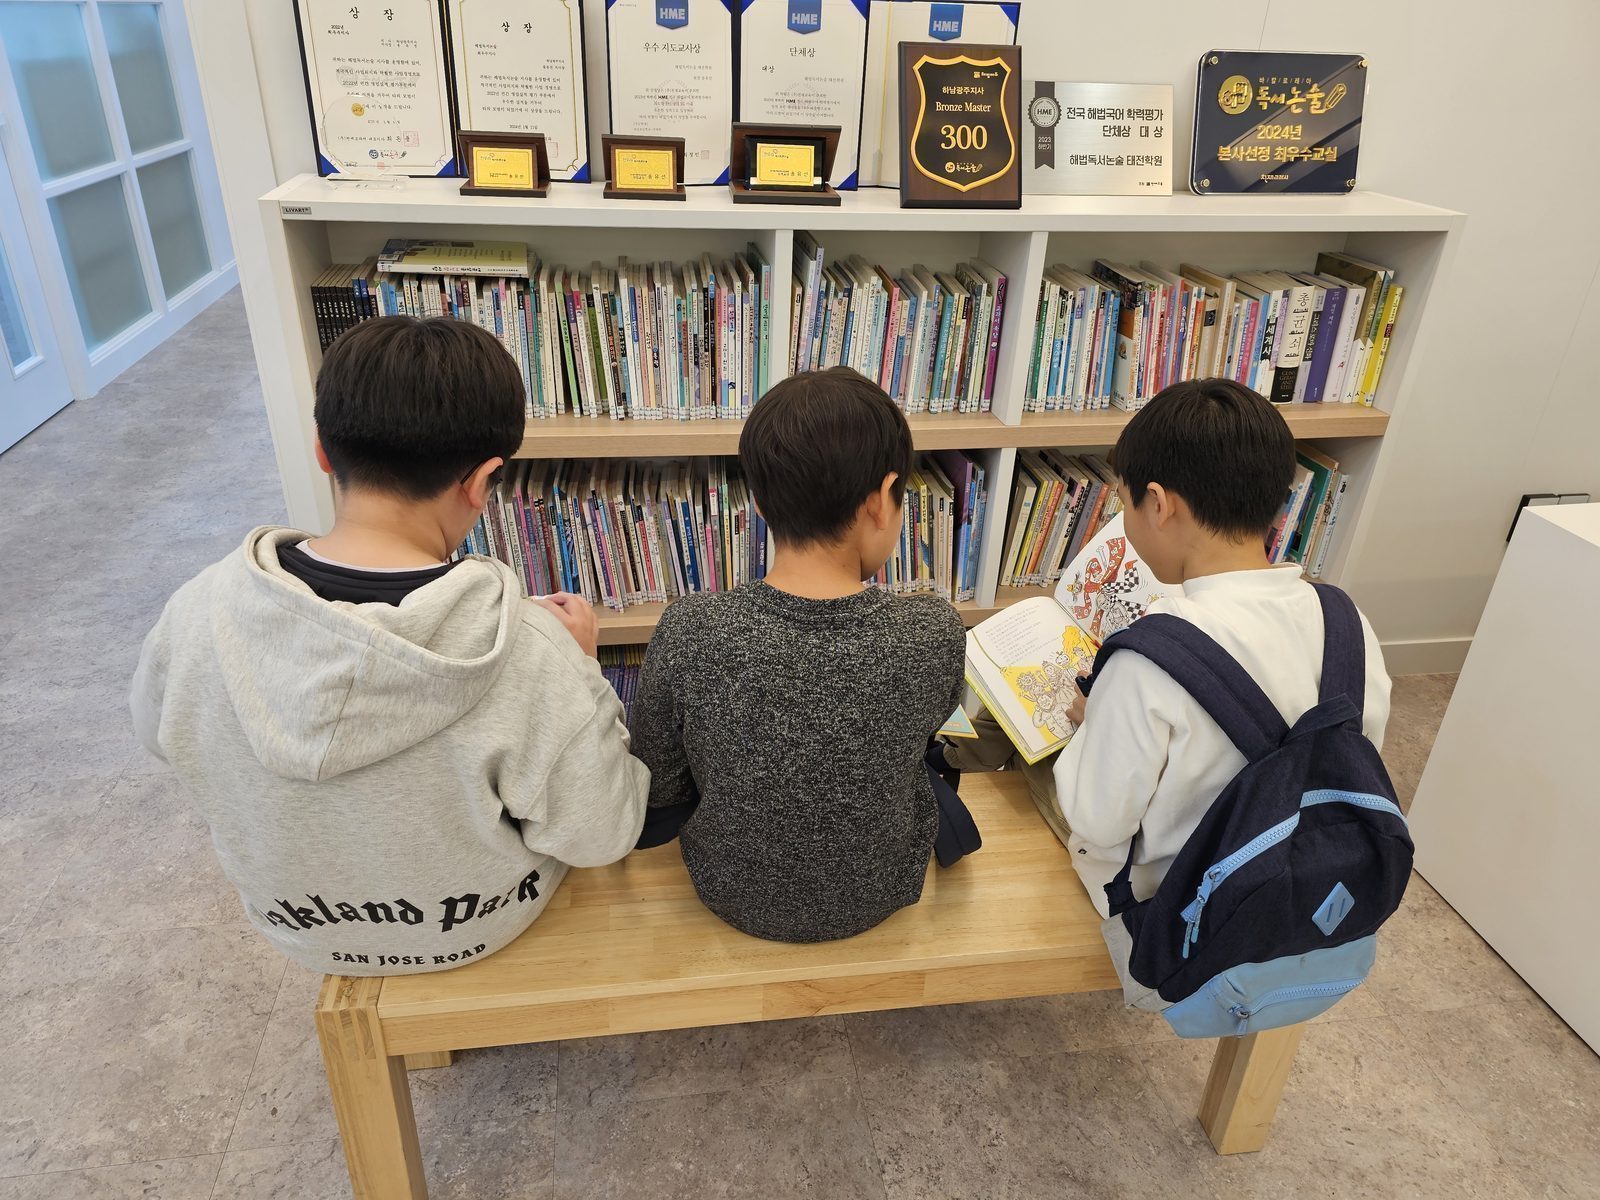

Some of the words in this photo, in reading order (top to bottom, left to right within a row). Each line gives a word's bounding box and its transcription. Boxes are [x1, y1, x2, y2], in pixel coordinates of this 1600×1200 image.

[349, 6, 359, 19] 상
[384, 8, 394, 21] 장
[660, 8, 685, 20] HME
[792, 13, 817, 25] HME
[501, 22, 510, 32] 상
[523, 22, 532, 33] 장
[933, 20, 959, 32] HME
[644, 43, 659, 52] 우수
[662, 43, 700, 54] 지도교사상
[789, 47, 816, 58] 단체상
[762, 65, 774, 74] 대상
[942, 86, 984, 95] 하남광주지사
[1256, 84, 1326, 114] 독서논술
[936, 101, 963, 112] Bronze
[965, 102, 991, 113] Master
[1067, 107, 1085, 119] 전국
[1087, 108, 1124, 120] 해법국어
[1127, 108, 1163, 121] 학력평가
[940, 124, 988, 150] 300
[1102, 125, 1131, 137] 단체상
[1140, 126, 1149, 137] 대
[1153, 126, 1163, 138] 상
[1257, 124, 1302, 140] 2024년
[1070, 154, 1124, 166] 해법독서논술
[1127, 154, 1162, 166] 태전학원
[1217, 146, 1270, 162] 본사선정
[1274, 146, 1338, 162] 최우수교실
[262, 894, 424, 931] akland
[332, 952, 370, 964] SAN
[378, 955, 425, 966] JOSE
[434, 943, 486, 964] ROAD
